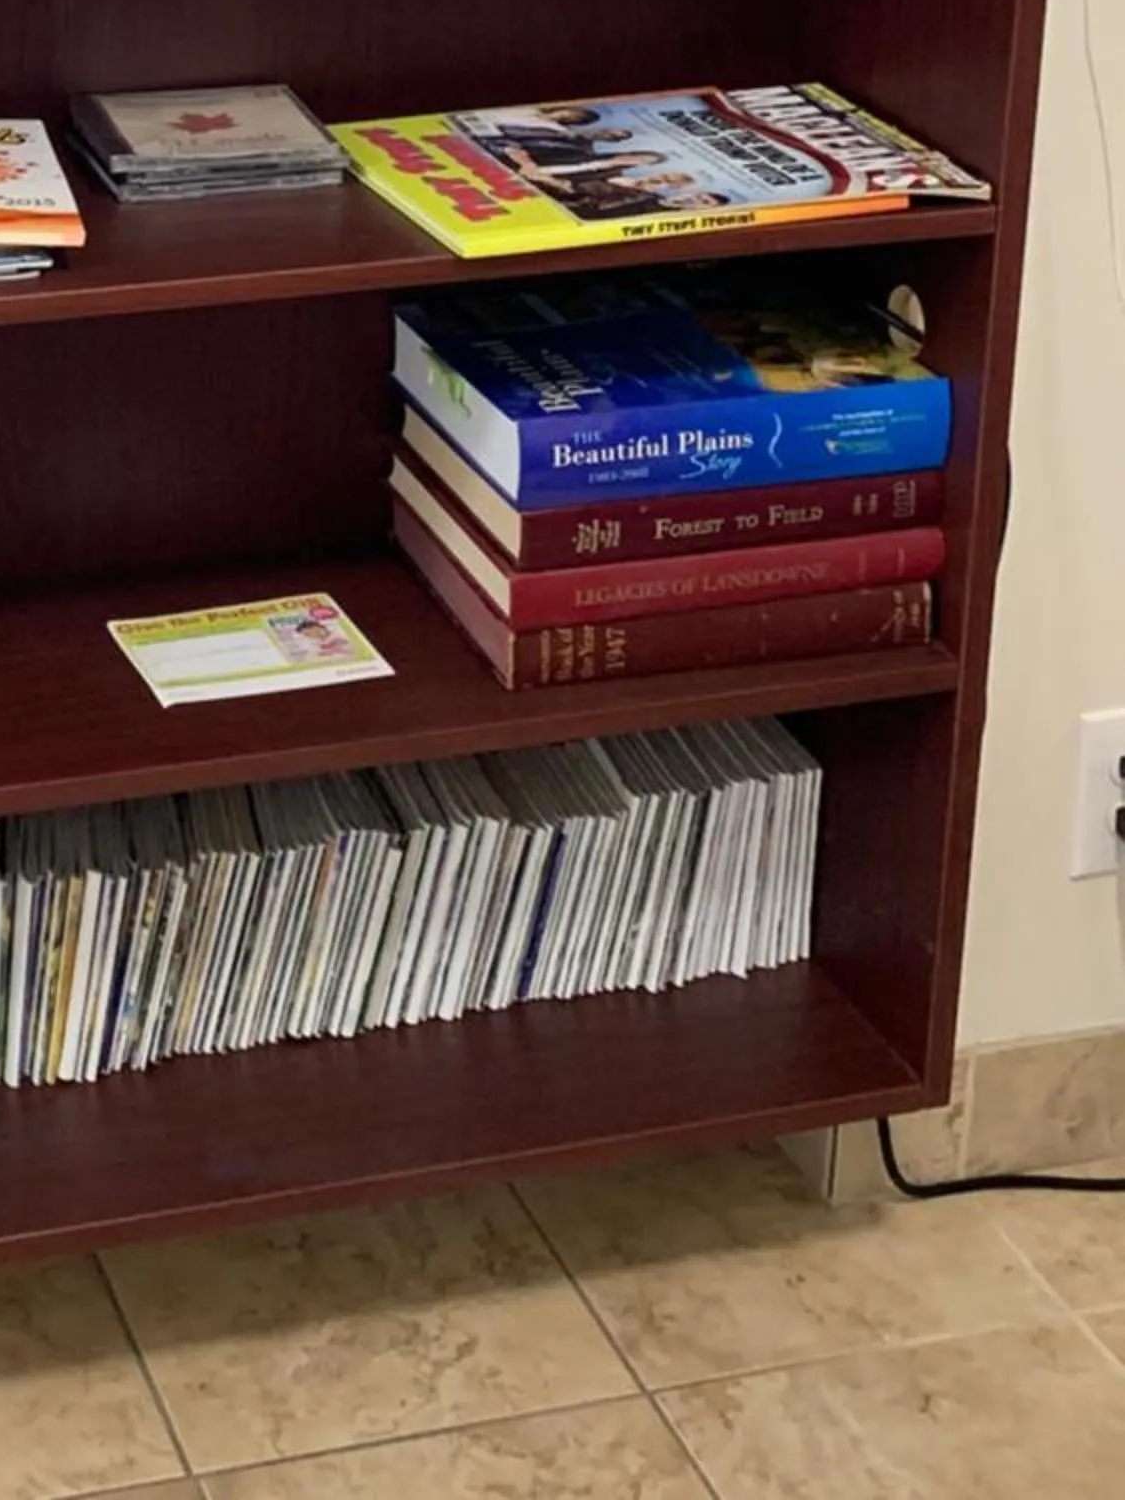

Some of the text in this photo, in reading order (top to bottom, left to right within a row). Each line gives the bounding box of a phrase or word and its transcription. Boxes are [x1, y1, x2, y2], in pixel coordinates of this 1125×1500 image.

[552, 428, 755, 468] Beautiful Plains
[679, 450, 743, 480] Story
[653, 504, 825, 540] FOREST TO FIELD
[576, 562, 832, 606] LEGACIES OF LANSDOWNE
